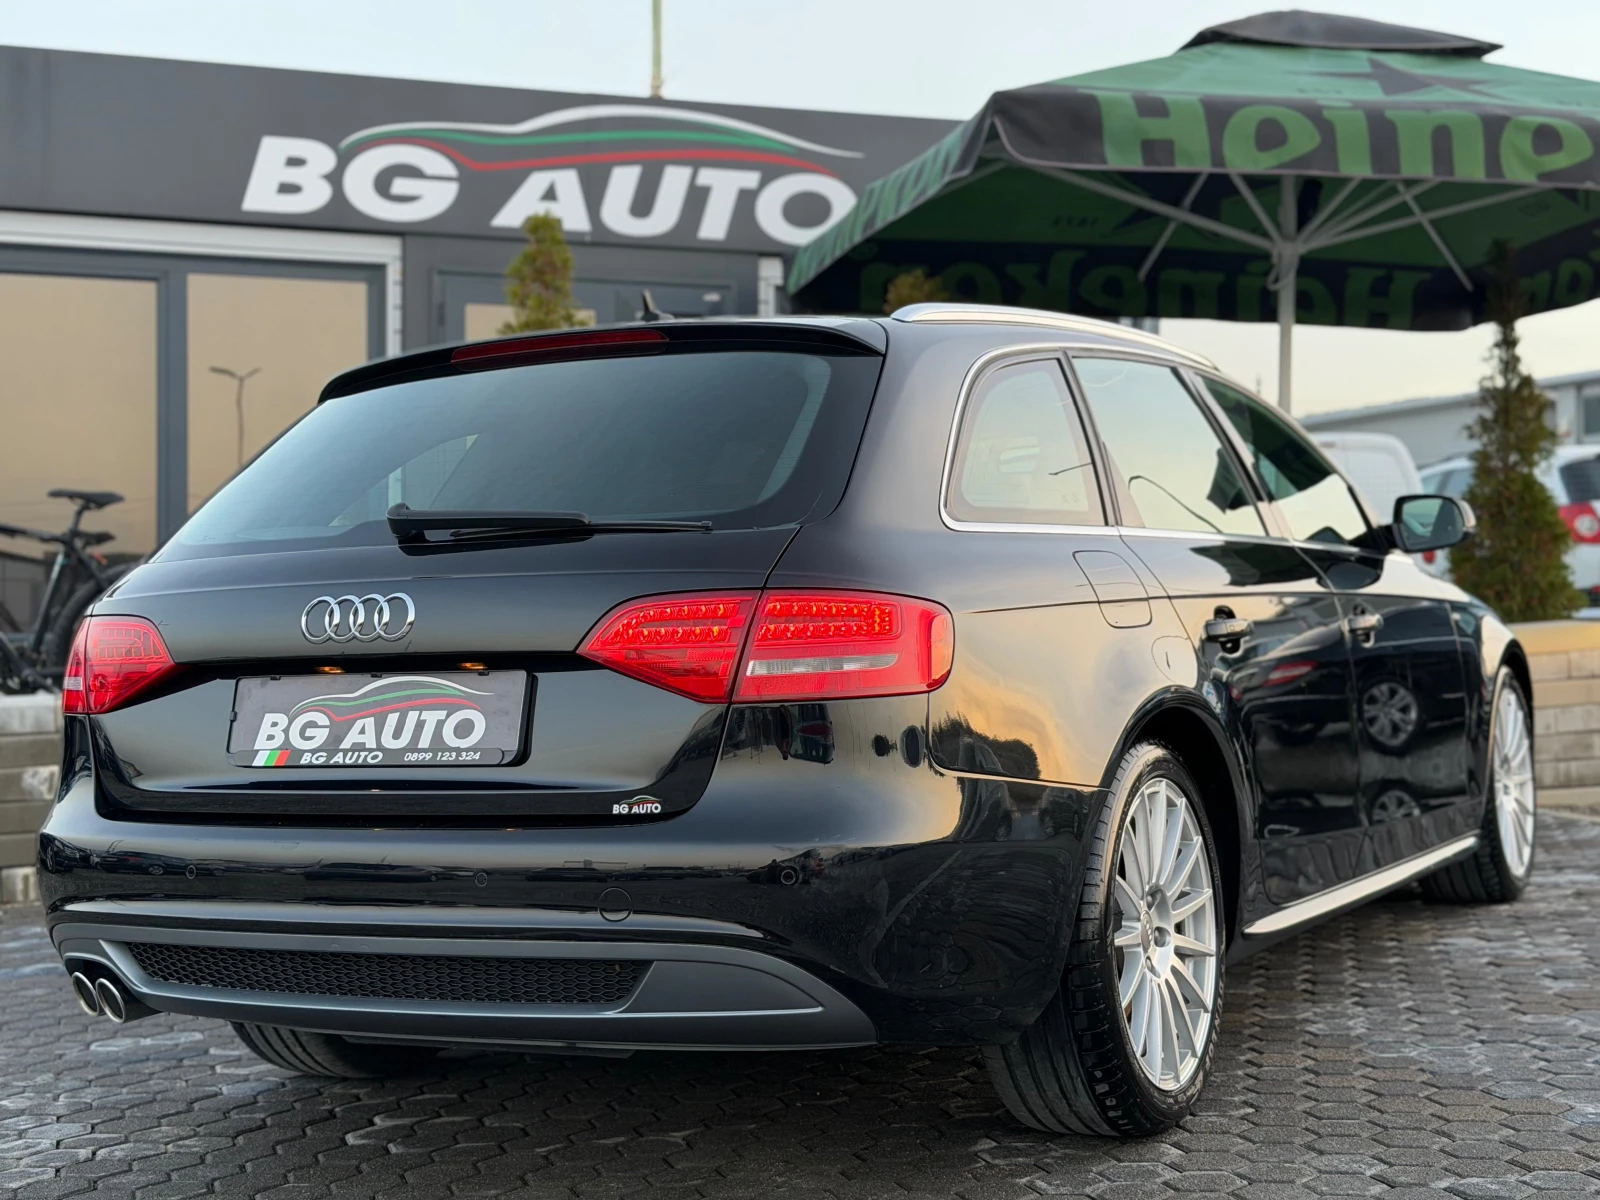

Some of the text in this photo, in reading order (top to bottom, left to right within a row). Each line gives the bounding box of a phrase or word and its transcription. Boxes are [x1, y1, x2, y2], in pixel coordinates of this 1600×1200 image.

[241, 135, 460, 223] BG
[490, 163, 858, 247] AUTO
[253, 709, 487, 751] BG AUTO
[299, 751, 481, 765] BG AUTO 0899 123 324
[612, 803, 662, 814] BG AUTO
